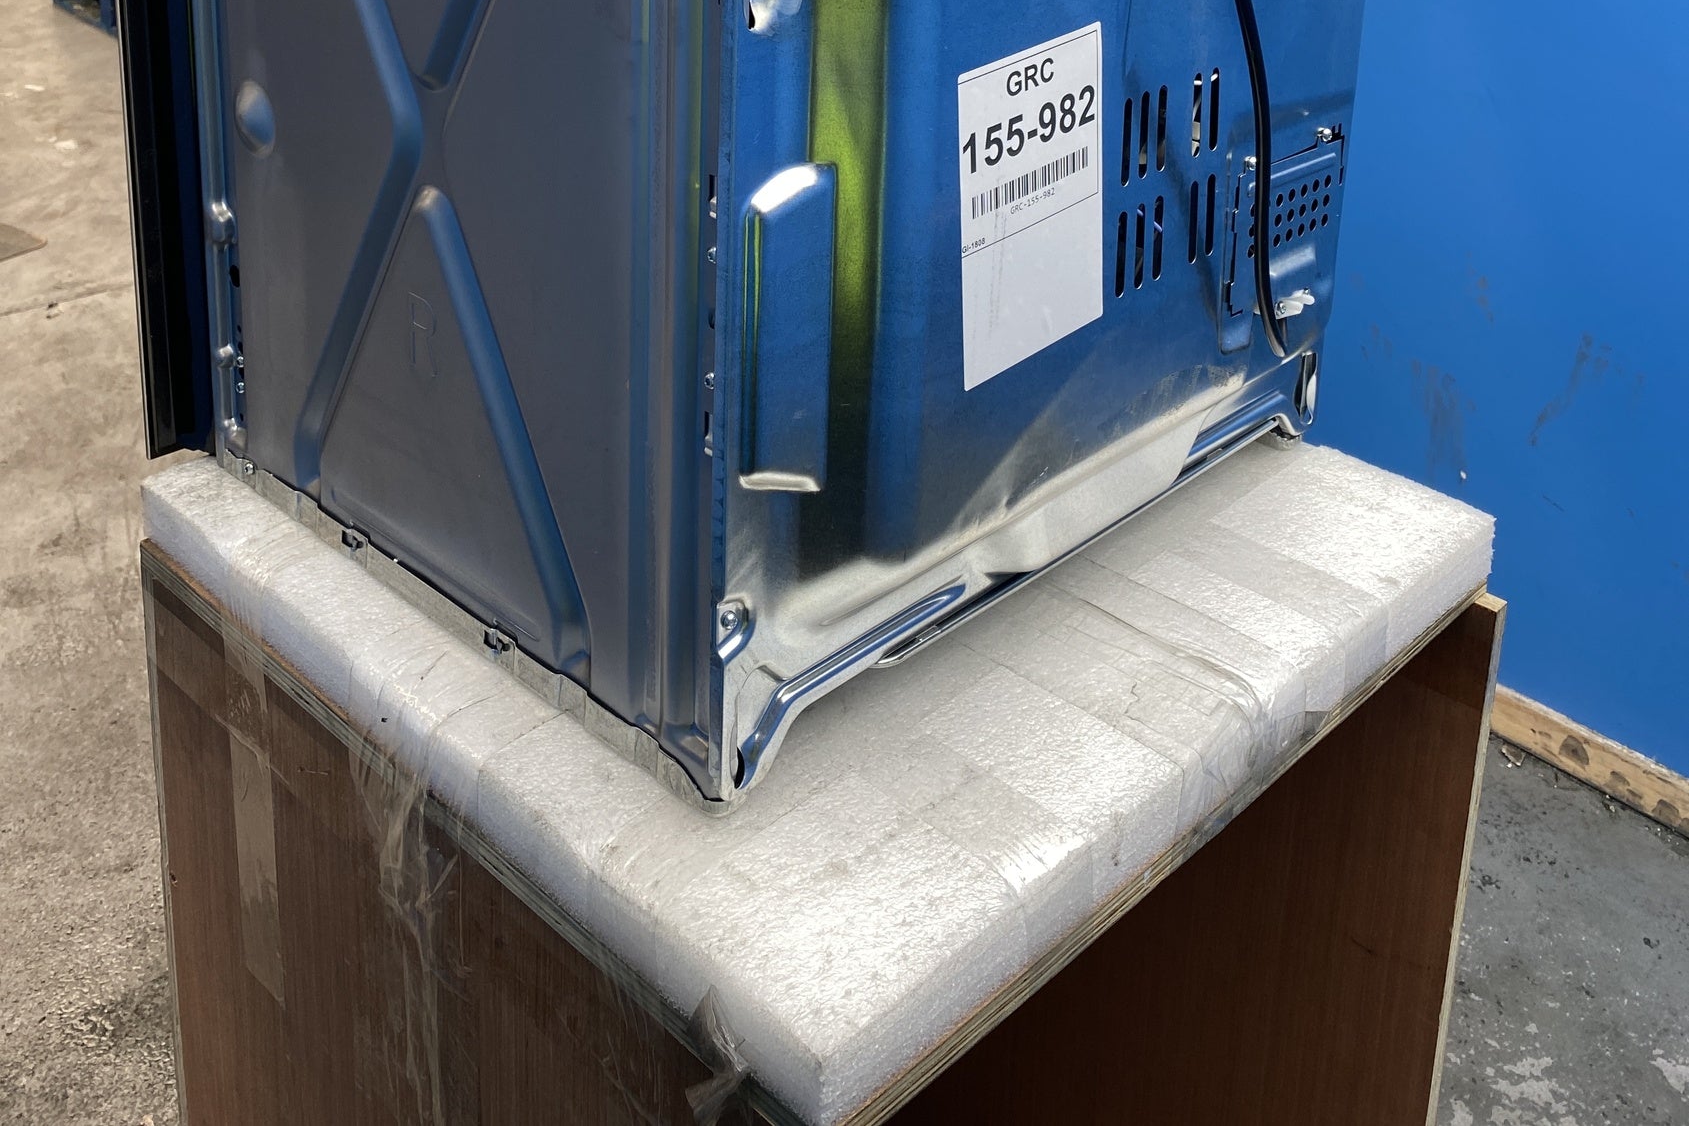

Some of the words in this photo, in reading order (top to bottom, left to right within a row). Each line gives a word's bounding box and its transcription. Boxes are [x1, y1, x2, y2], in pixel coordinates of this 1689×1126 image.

[1006, 57, 1055, 97] GRC
[962, 84, 1095, 174] 155-982
[1010, 187, 1055, 215] GRC-155-982
